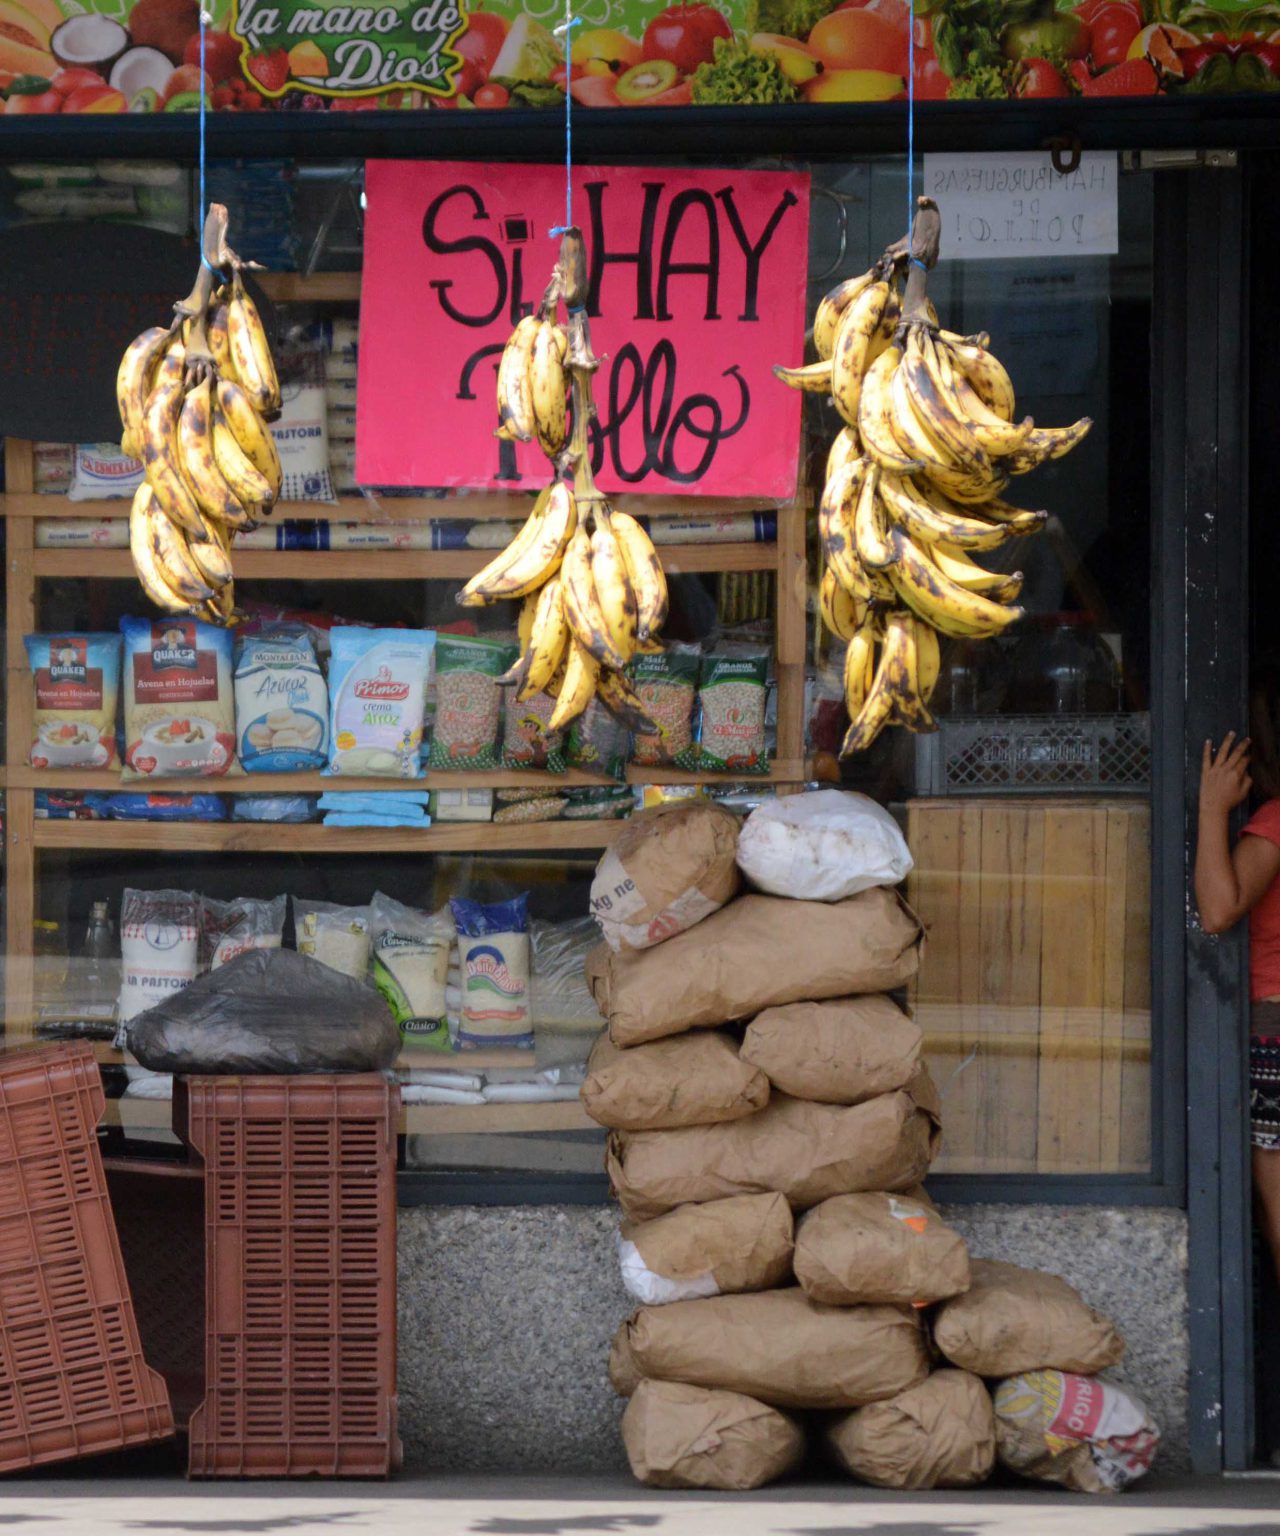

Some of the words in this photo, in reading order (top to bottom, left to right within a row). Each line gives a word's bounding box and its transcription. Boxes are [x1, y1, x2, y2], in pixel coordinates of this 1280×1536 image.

[236, 0, 281, 34] la
[287, 6, 402, 34] mano
[411, 0, 462, 32] de
[324, 39, 445, 87] Dios
[583, 181, 798, 322] HAY
[153, 648, 196, 661] QUAKER
[51, 666, 86, 677] QUAKER
[137, 680, 164, 689] Avena
[165, 680, 176, 688] en
[177, 676, 215, 688] Hojuelas
[356, 680, 409, 698] Primor
[37, 689, 59, 697] Avena
[363, 702, 392, 712] crema
[362, 712, 400, 726] Arroz
[591, 891, 612, 911] kg
[405, 1019, 437, 1031] Clásico
